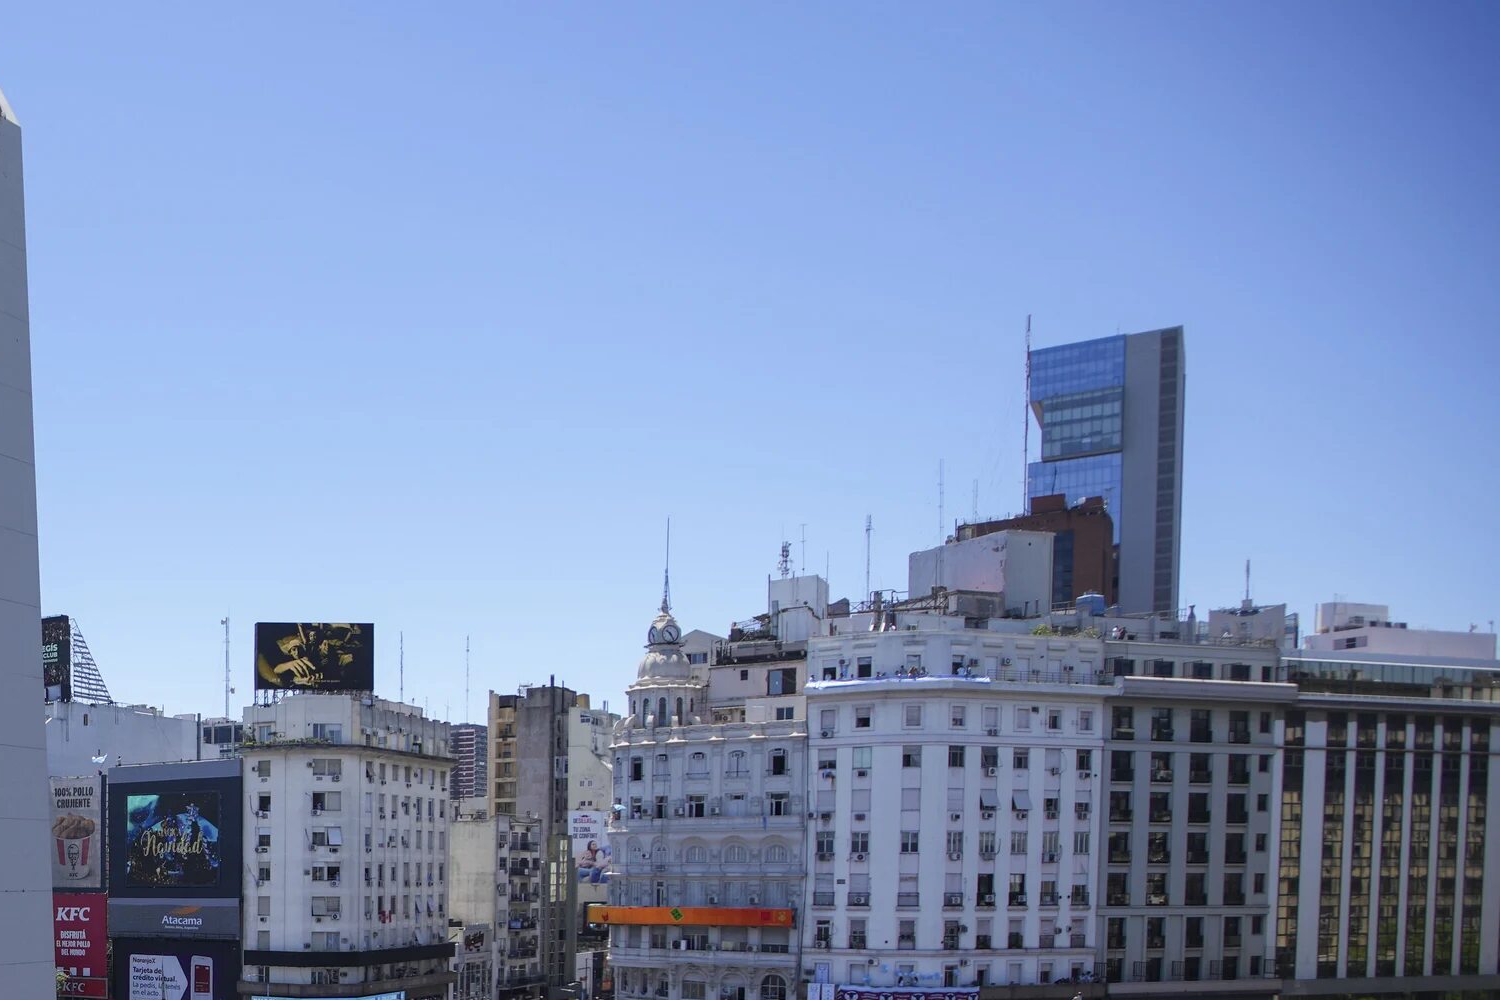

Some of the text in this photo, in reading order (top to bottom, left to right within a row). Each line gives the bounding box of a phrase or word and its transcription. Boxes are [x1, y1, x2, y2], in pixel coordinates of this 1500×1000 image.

[54, 786, 94, 797] 100% POLLO
[56, 798, 91, 808] CRUJIENTE
[56, 907, 91, 921] KFC
[162, 915, 202, 925] Atacama
[60, 929, 86, 939] DISFRUTÁ
[62, 940, 76, 948] MEJOR
[76, 940, 91, 948] POLLO
[132, 966, 153, 974] Tarjeta
[62, 982, 86, 992] KFC
